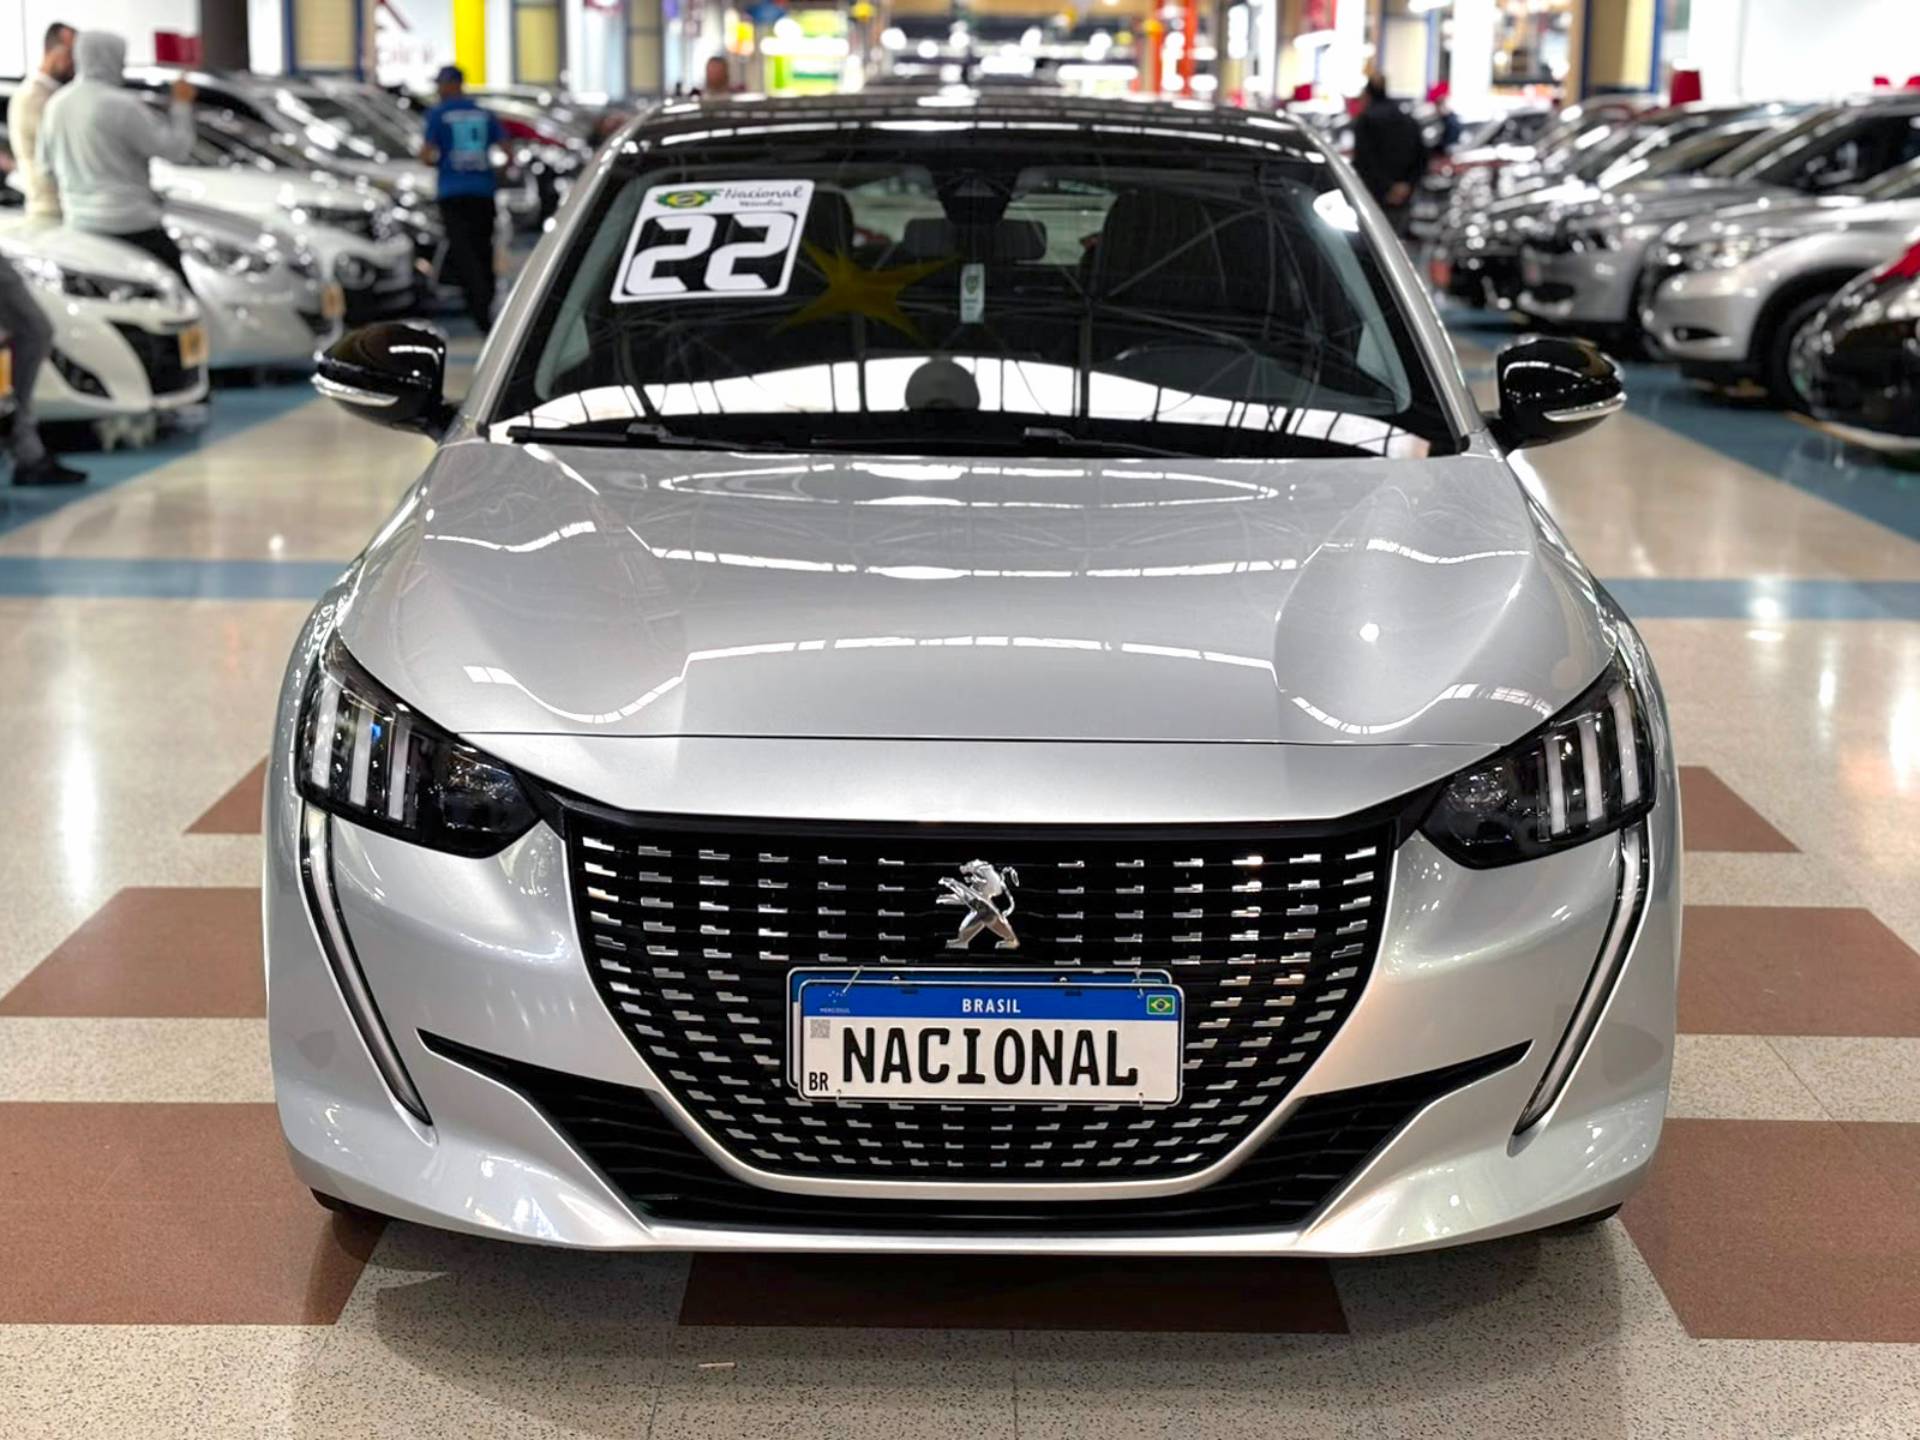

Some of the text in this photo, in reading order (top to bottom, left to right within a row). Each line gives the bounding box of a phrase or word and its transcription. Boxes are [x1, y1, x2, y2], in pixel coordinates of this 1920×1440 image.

[724, 184, 803, 199] Nacional
[624, 212, 796, 295] 22
[962, 998, 1022, 1014] BRASIL
[842, 1026, 1139, 1087] NACIONAL
[808, 1071, 829, 1092] BR
